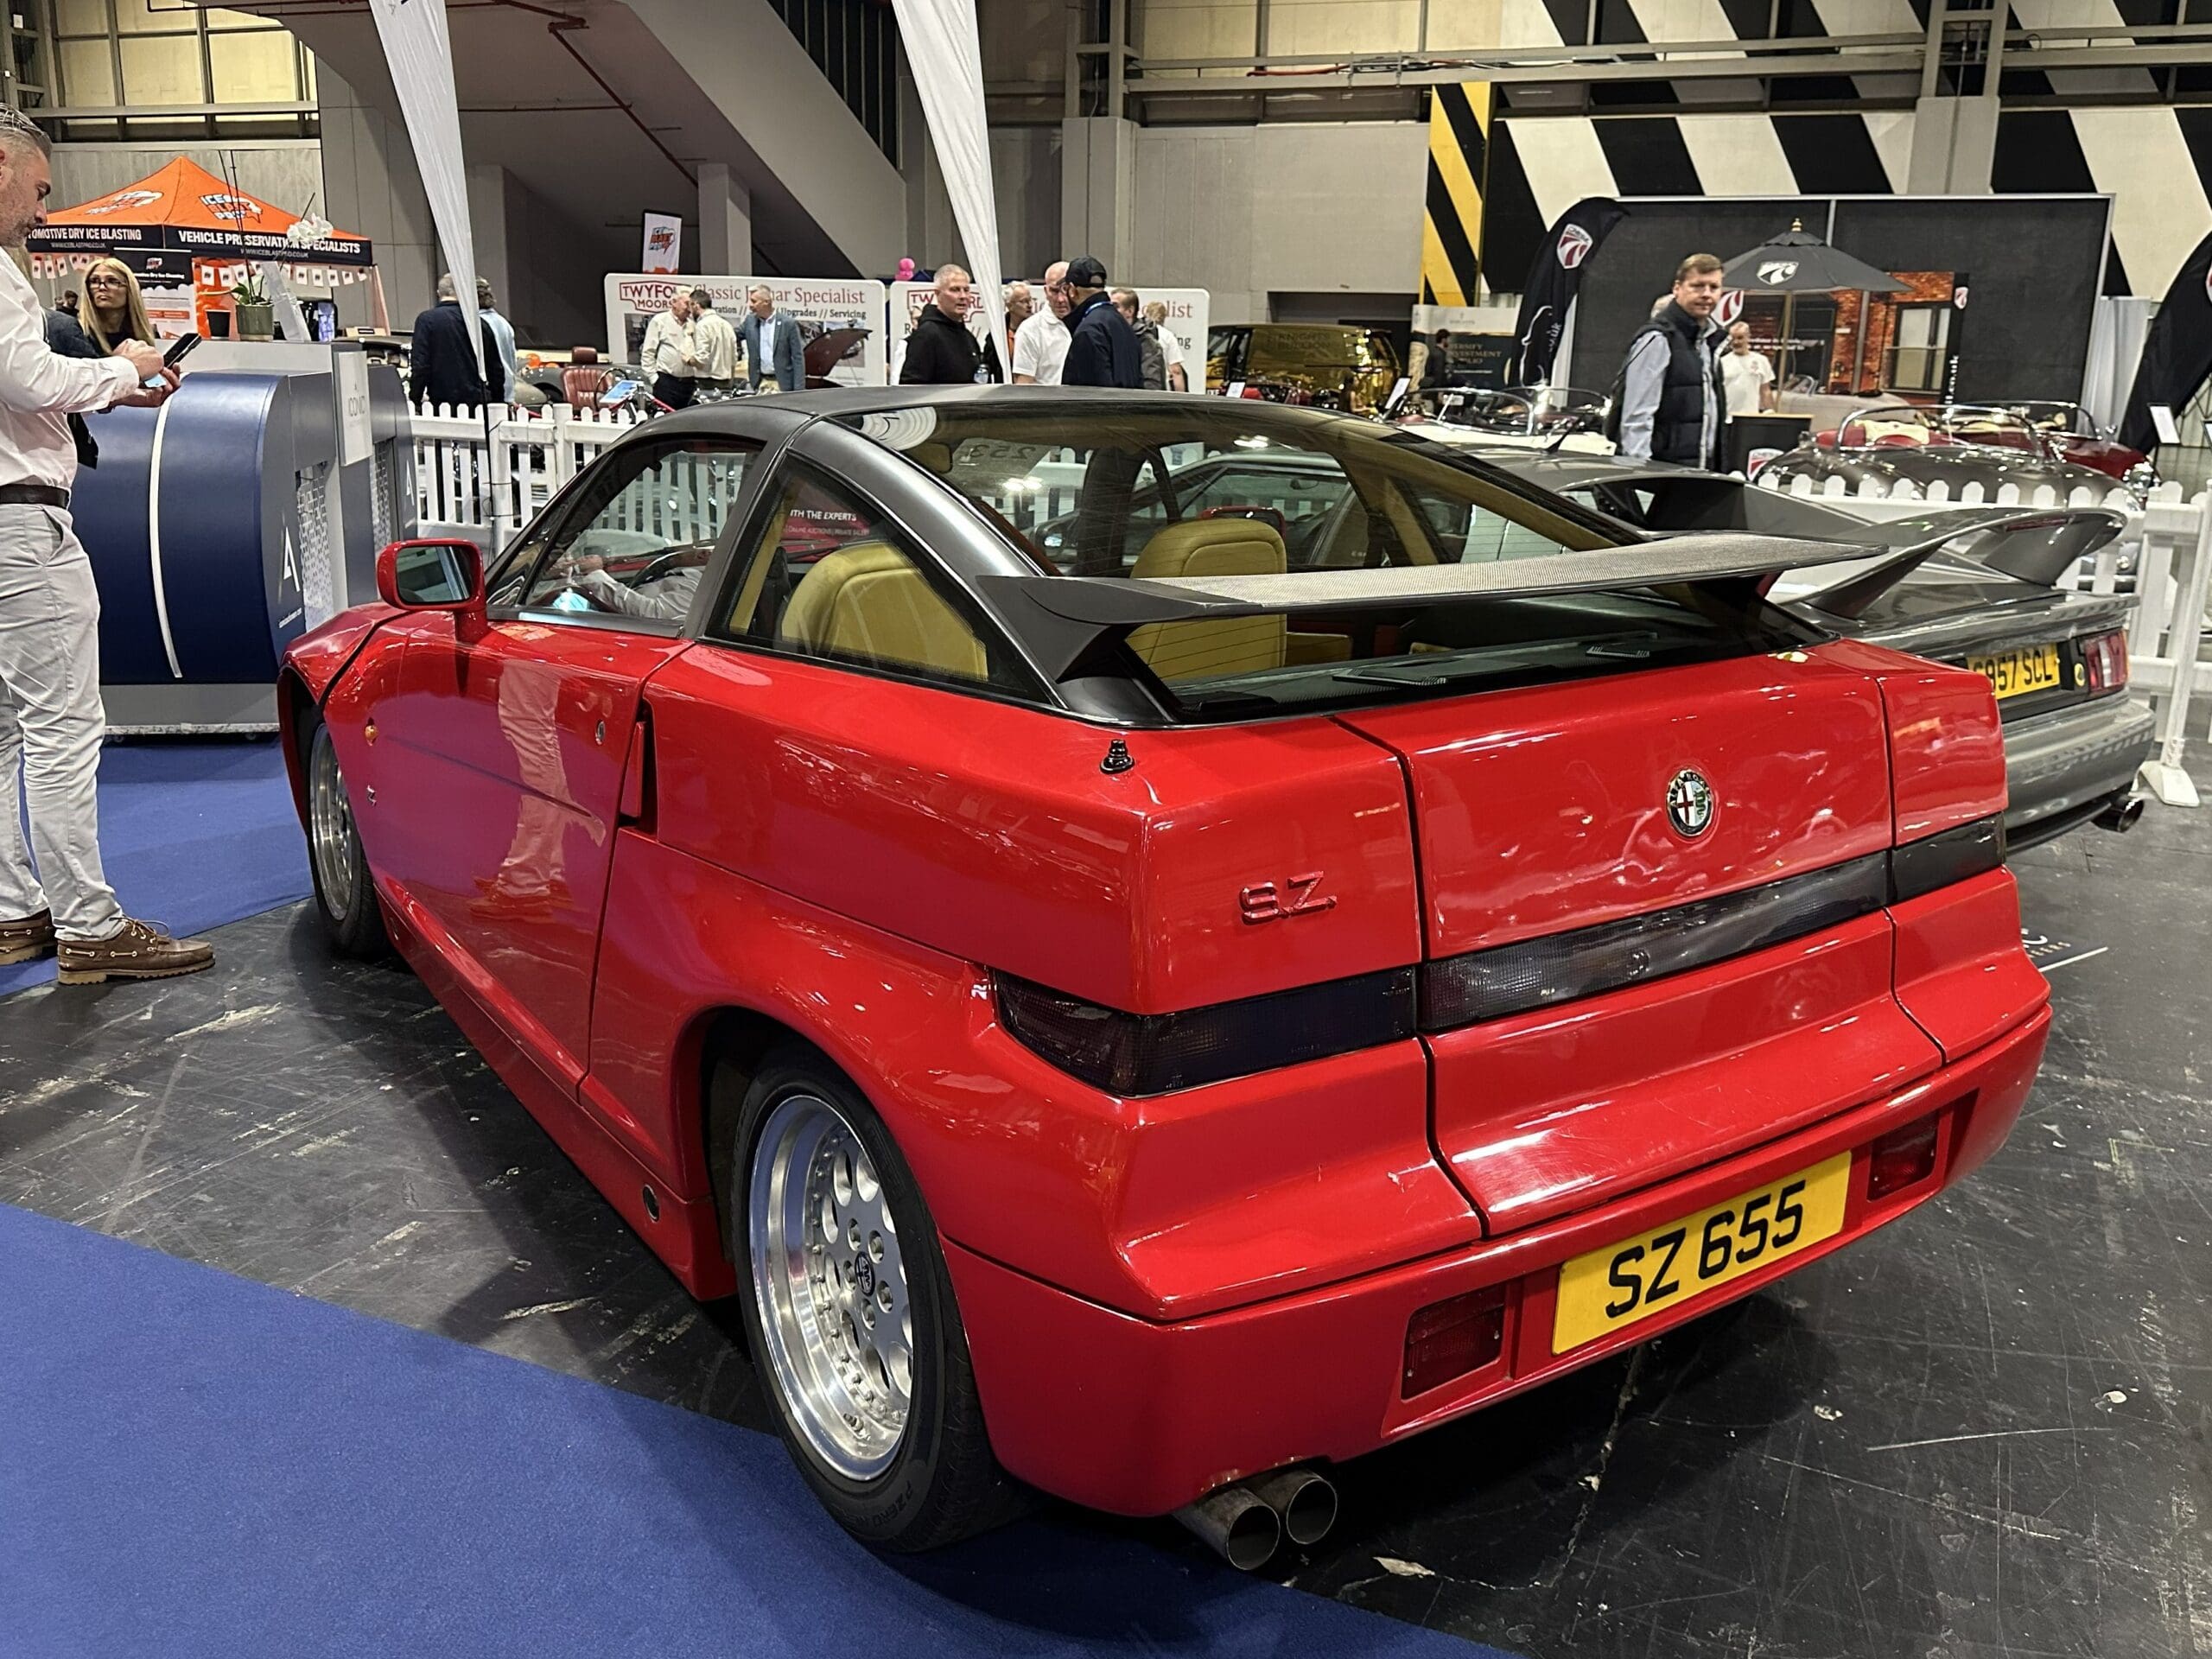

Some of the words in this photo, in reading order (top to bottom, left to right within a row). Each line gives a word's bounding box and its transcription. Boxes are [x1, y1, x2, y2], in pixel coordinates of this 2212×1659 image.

[68, 228, 84, 239] DRY
[86, 228, 99, 239] ICE
[101, 228, 143, 240] BLASTING
[178, 230, 224, 245] VEHICLE
[302, 238, 360, 253] SPECIALISTS
[622, 284, 677, 299] TWYFO
[794, 287, 865, 307] Specialist
[830, 310, 867, 320] Servicing
[790, 509, 805, 518] ITH
[806, 510, 823, 520] THE
[823, 512, 857, 521] EXPERTS
[2022, 648, 2053, 686] SCL
[1238, 870, 1338, 925] SZ
[1605, 1227, 1688, 1319] SZ
[1698, 1179, 1807, 1281] 655
